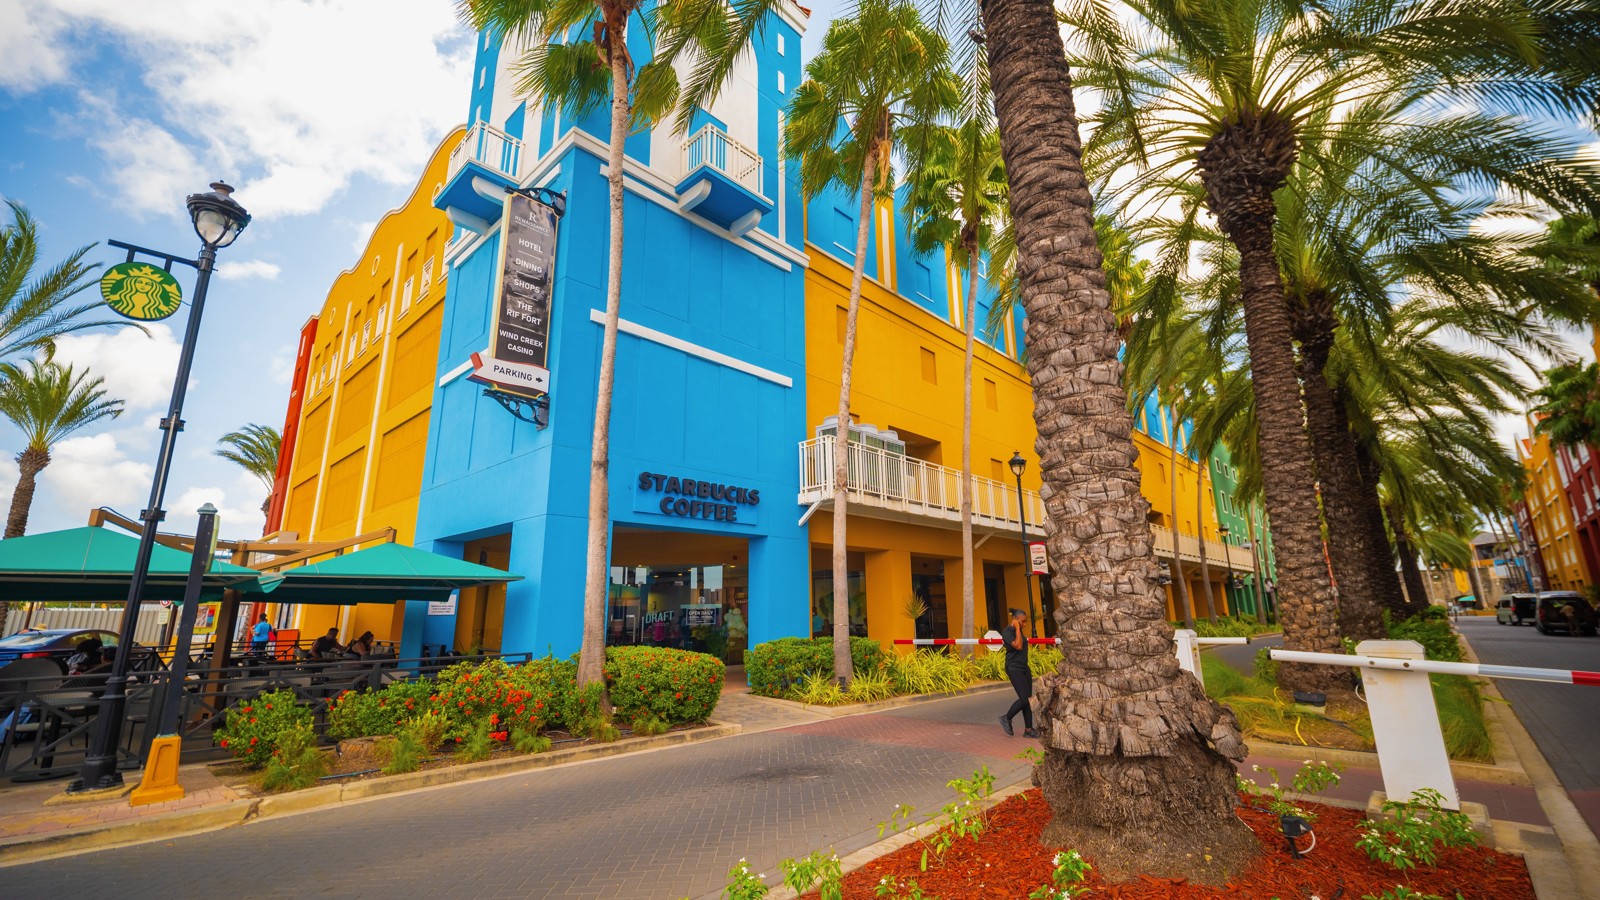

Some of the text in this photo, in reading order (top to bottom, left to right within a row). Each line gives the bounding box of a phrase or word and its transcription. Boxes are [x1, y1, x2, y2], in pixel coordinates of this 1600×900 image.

[514, 215, 550, 234] RENAISSANCE
[518, 238, 543, 254] HOTEL
[515, 257, 543, 273] DINING
[513, 278, 540, 294] SHOPS
[517, 300, 533, 312] THE
[506, 308, 542, 326] RIF FORT
[499, 329, 543, 348] WIND CREEK
[507, 343, 534, 356] CASINO
[493, 364, 533, 382] PARKING
[638, 471, 760, 505] STARBUCKS
[660, 496, 737, 521] COFFEE
[645, 610, 674, 624] DRAFT
